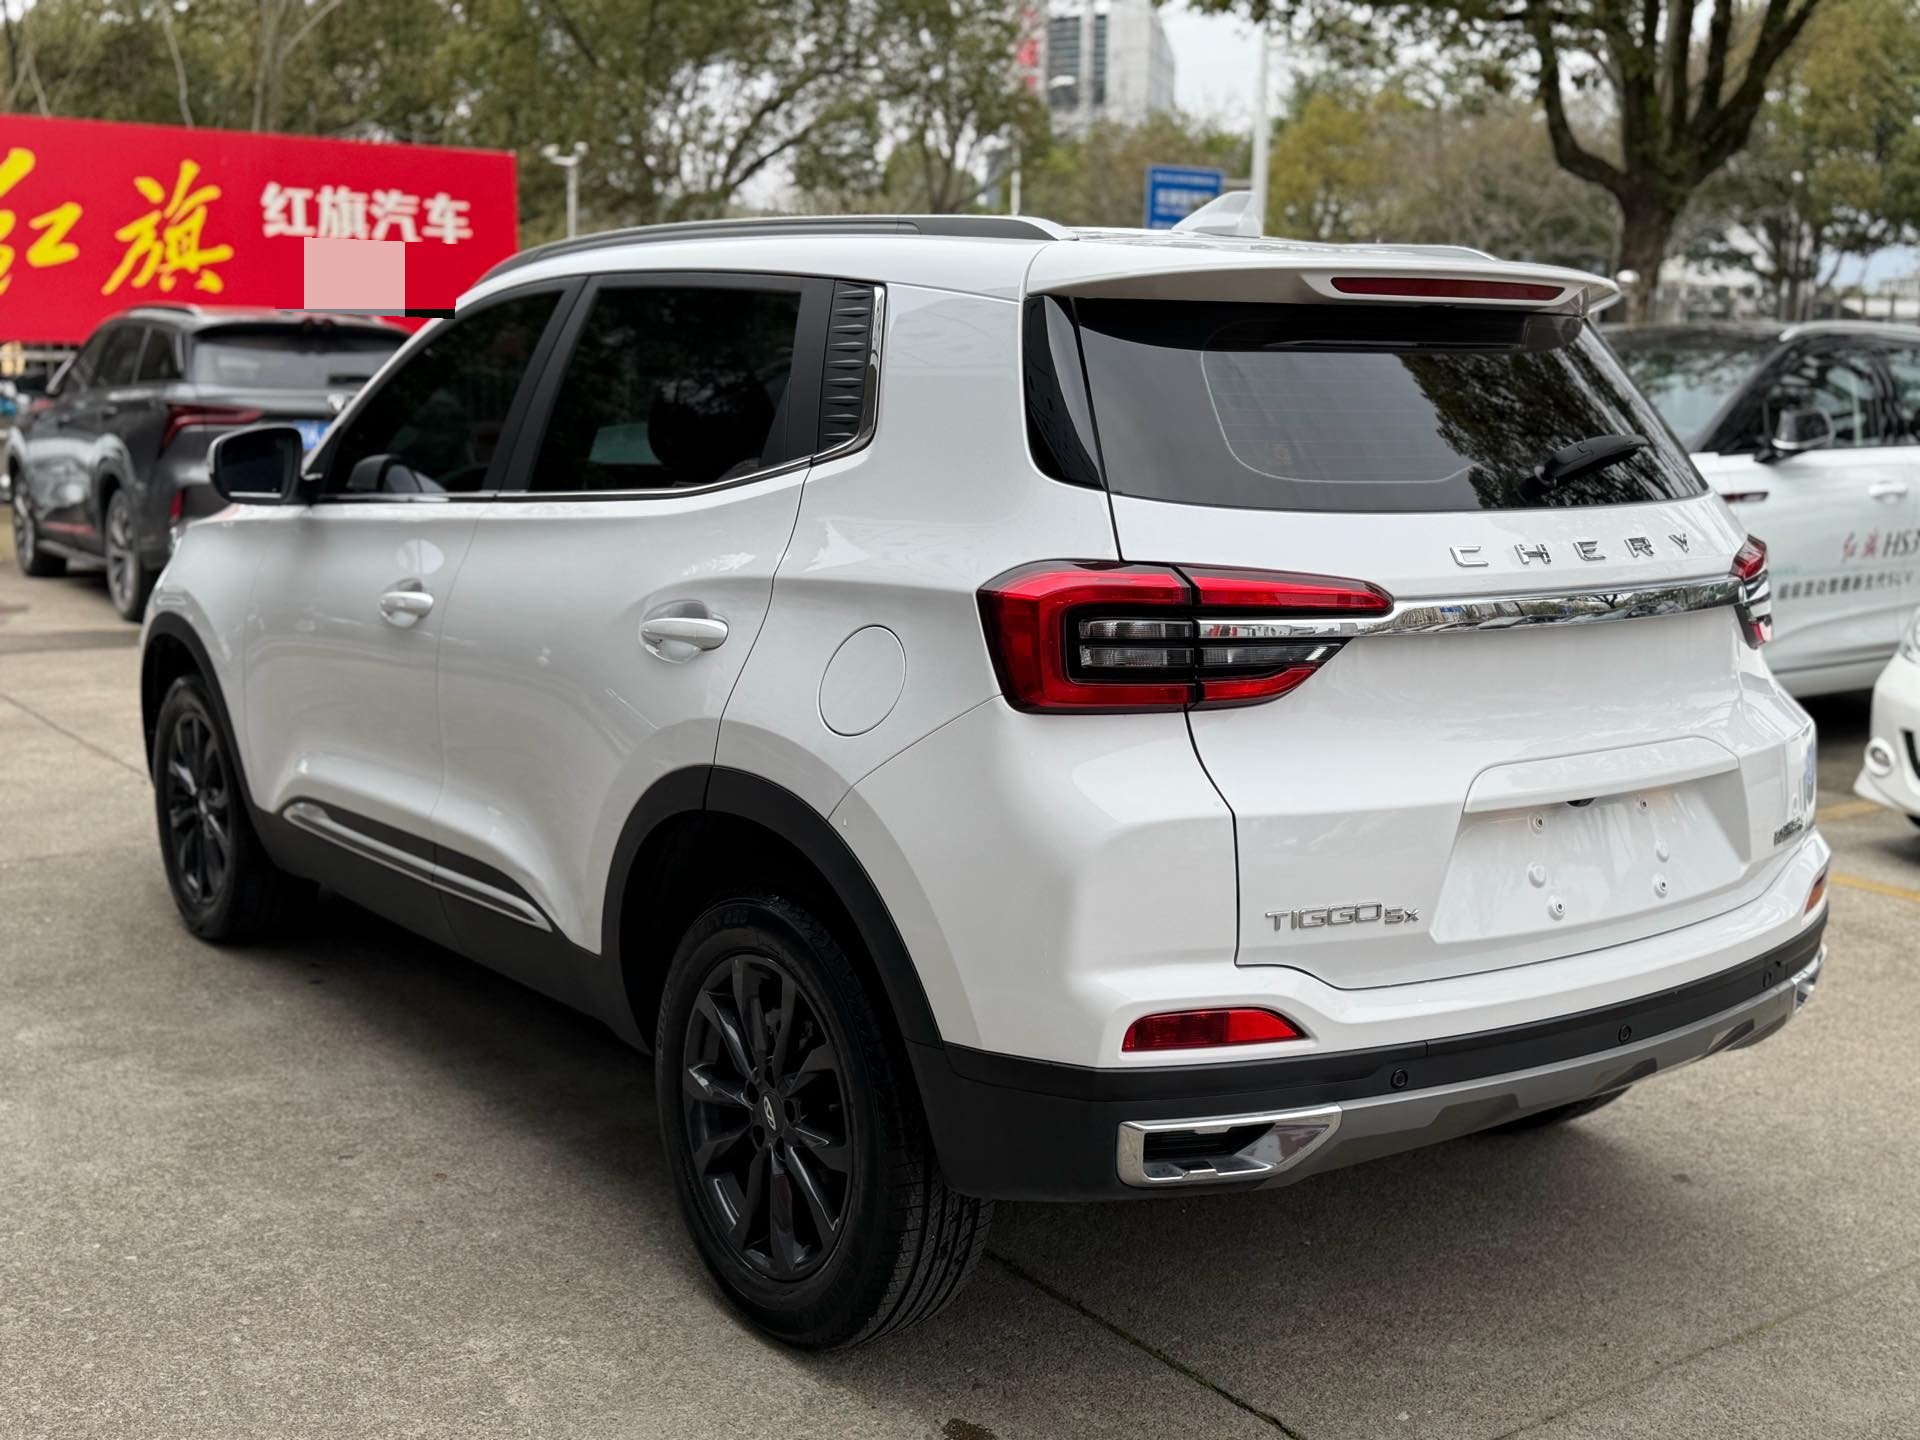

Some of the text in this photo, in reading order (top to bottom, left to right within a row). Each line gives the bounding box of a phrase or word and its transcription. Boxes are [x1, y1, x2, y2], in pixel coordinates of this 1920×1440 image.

[260, 181, 473, 244] 红旗汽车
[1449, 532, 1690, 567] CHERY
[1265, 902, 1382, 932] TIGGO
